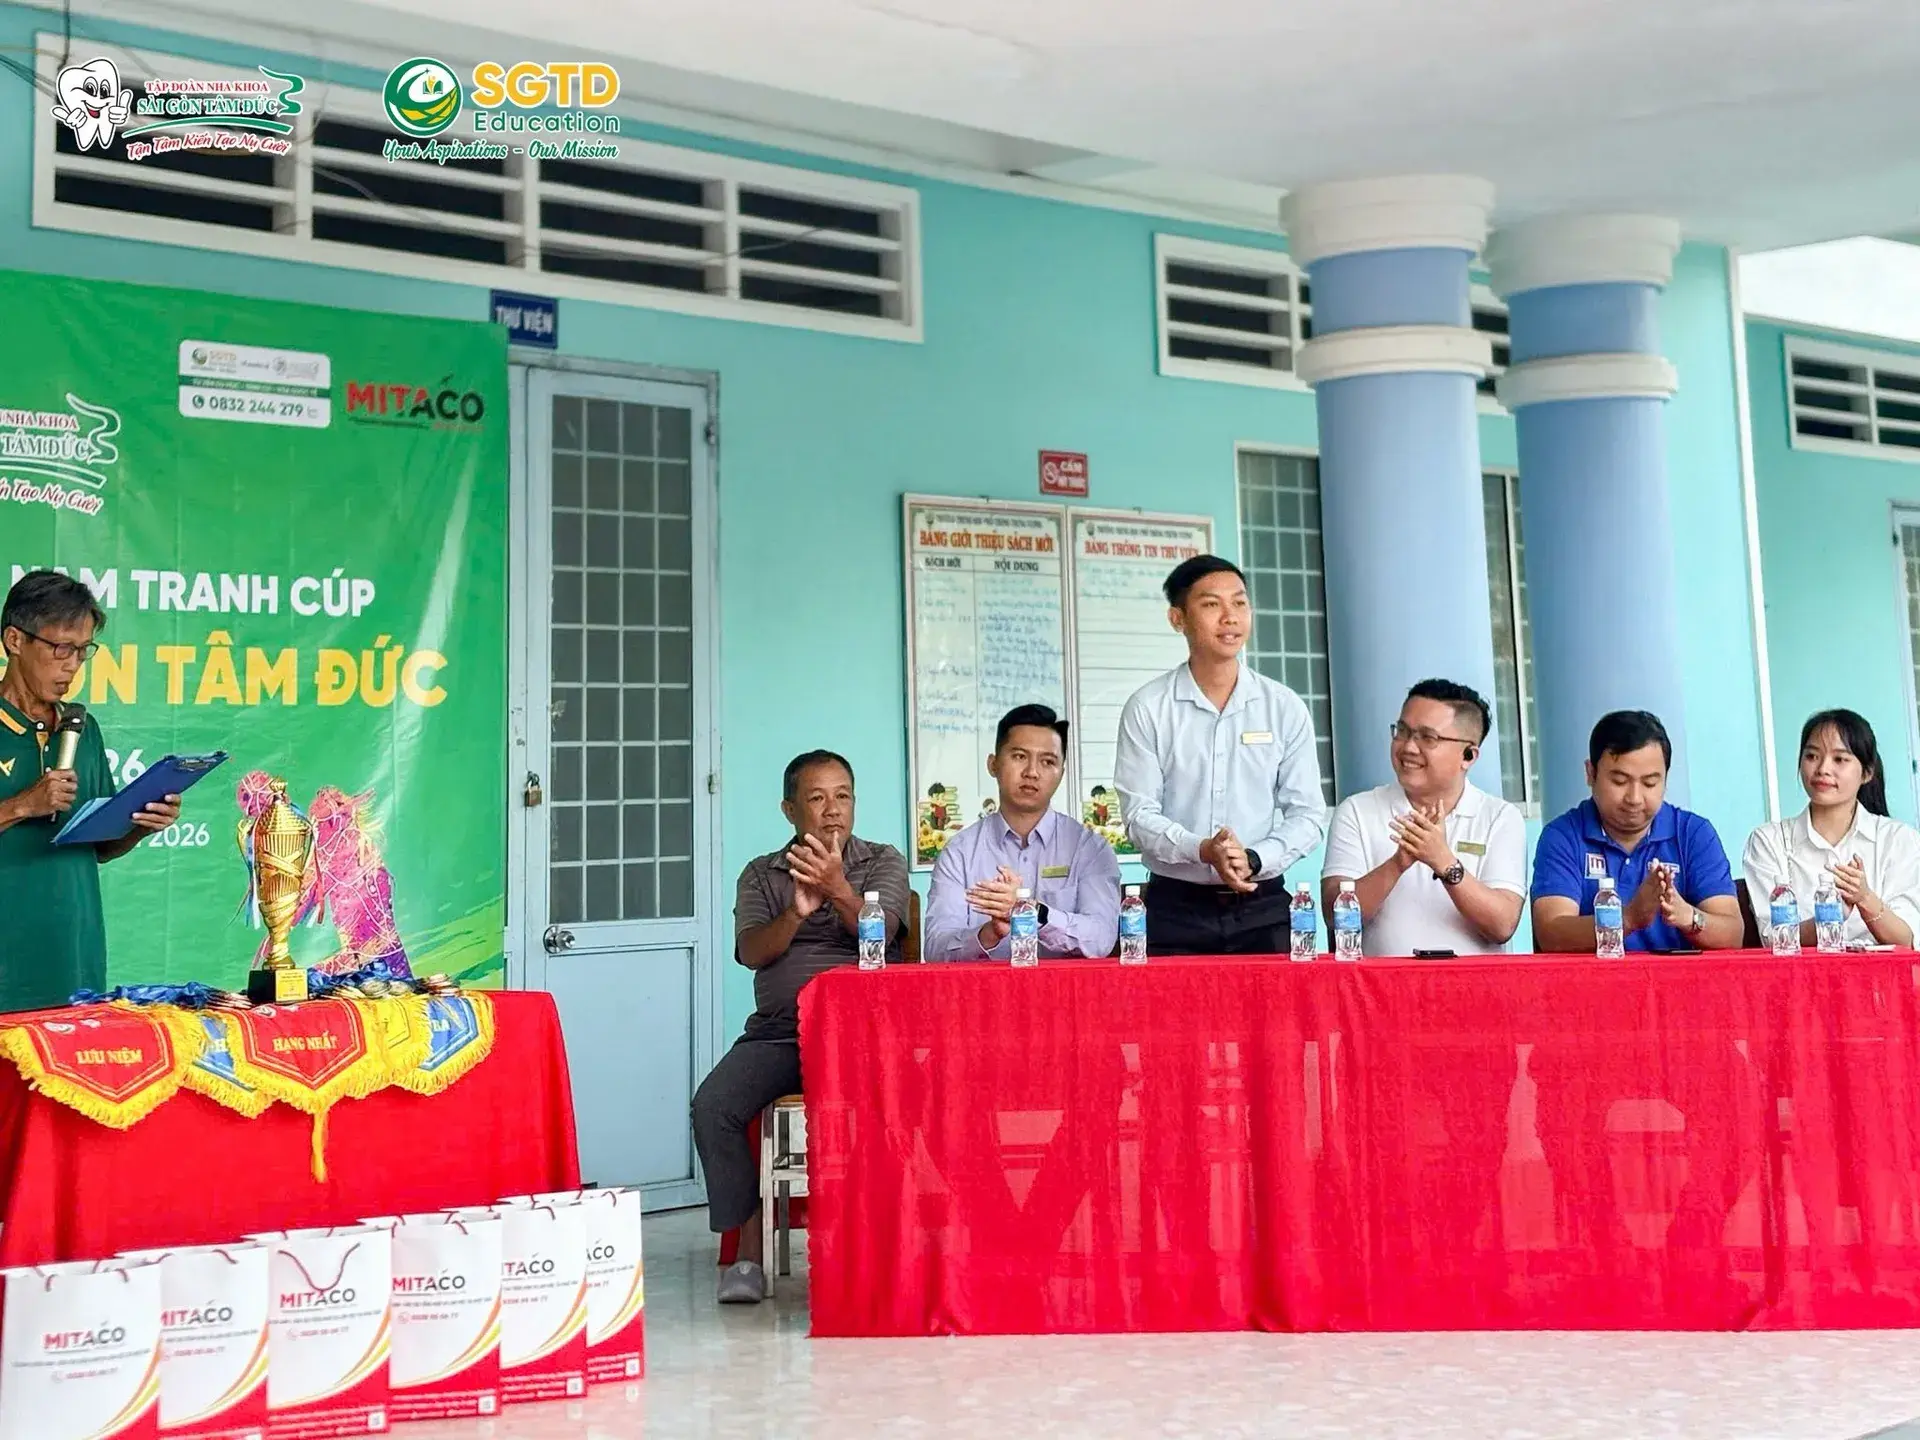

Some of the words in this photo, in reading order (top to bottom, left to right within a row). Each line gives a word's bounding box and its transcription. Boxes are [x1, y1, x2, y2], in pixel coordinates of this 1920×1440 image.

[209, 395, 244, 412] 0832
[248, 400, 276, 415] 244
[279, 402, 304, 417] 279
[6, 411, 33, 427] NHA
[38, 414, 78, 429] KHOA
[4, 429, 45, 455] TÂM
[46, 431, 89, 459] ĐỨC
[14, 481, 39, 502] Tạo
[41, 485, 63, 507] Nụ
[68, 490, 101, 514] Cười
[1007, 531, 1033, 551] SÁCH
[994, 557, 1010, 573] NỘI
[1013, 560, 1039, 572] DUNG
[130, 569, 279, 615] TRANH
[290, 568, 376, 617] CÚP
[156, 630, 298, 706] TÂM
[314, 634, 448, 707] ĐỨC
[272, 1037, 305, 1054] HẠNG
[305, 1030, 337, 1050] NHẤT
